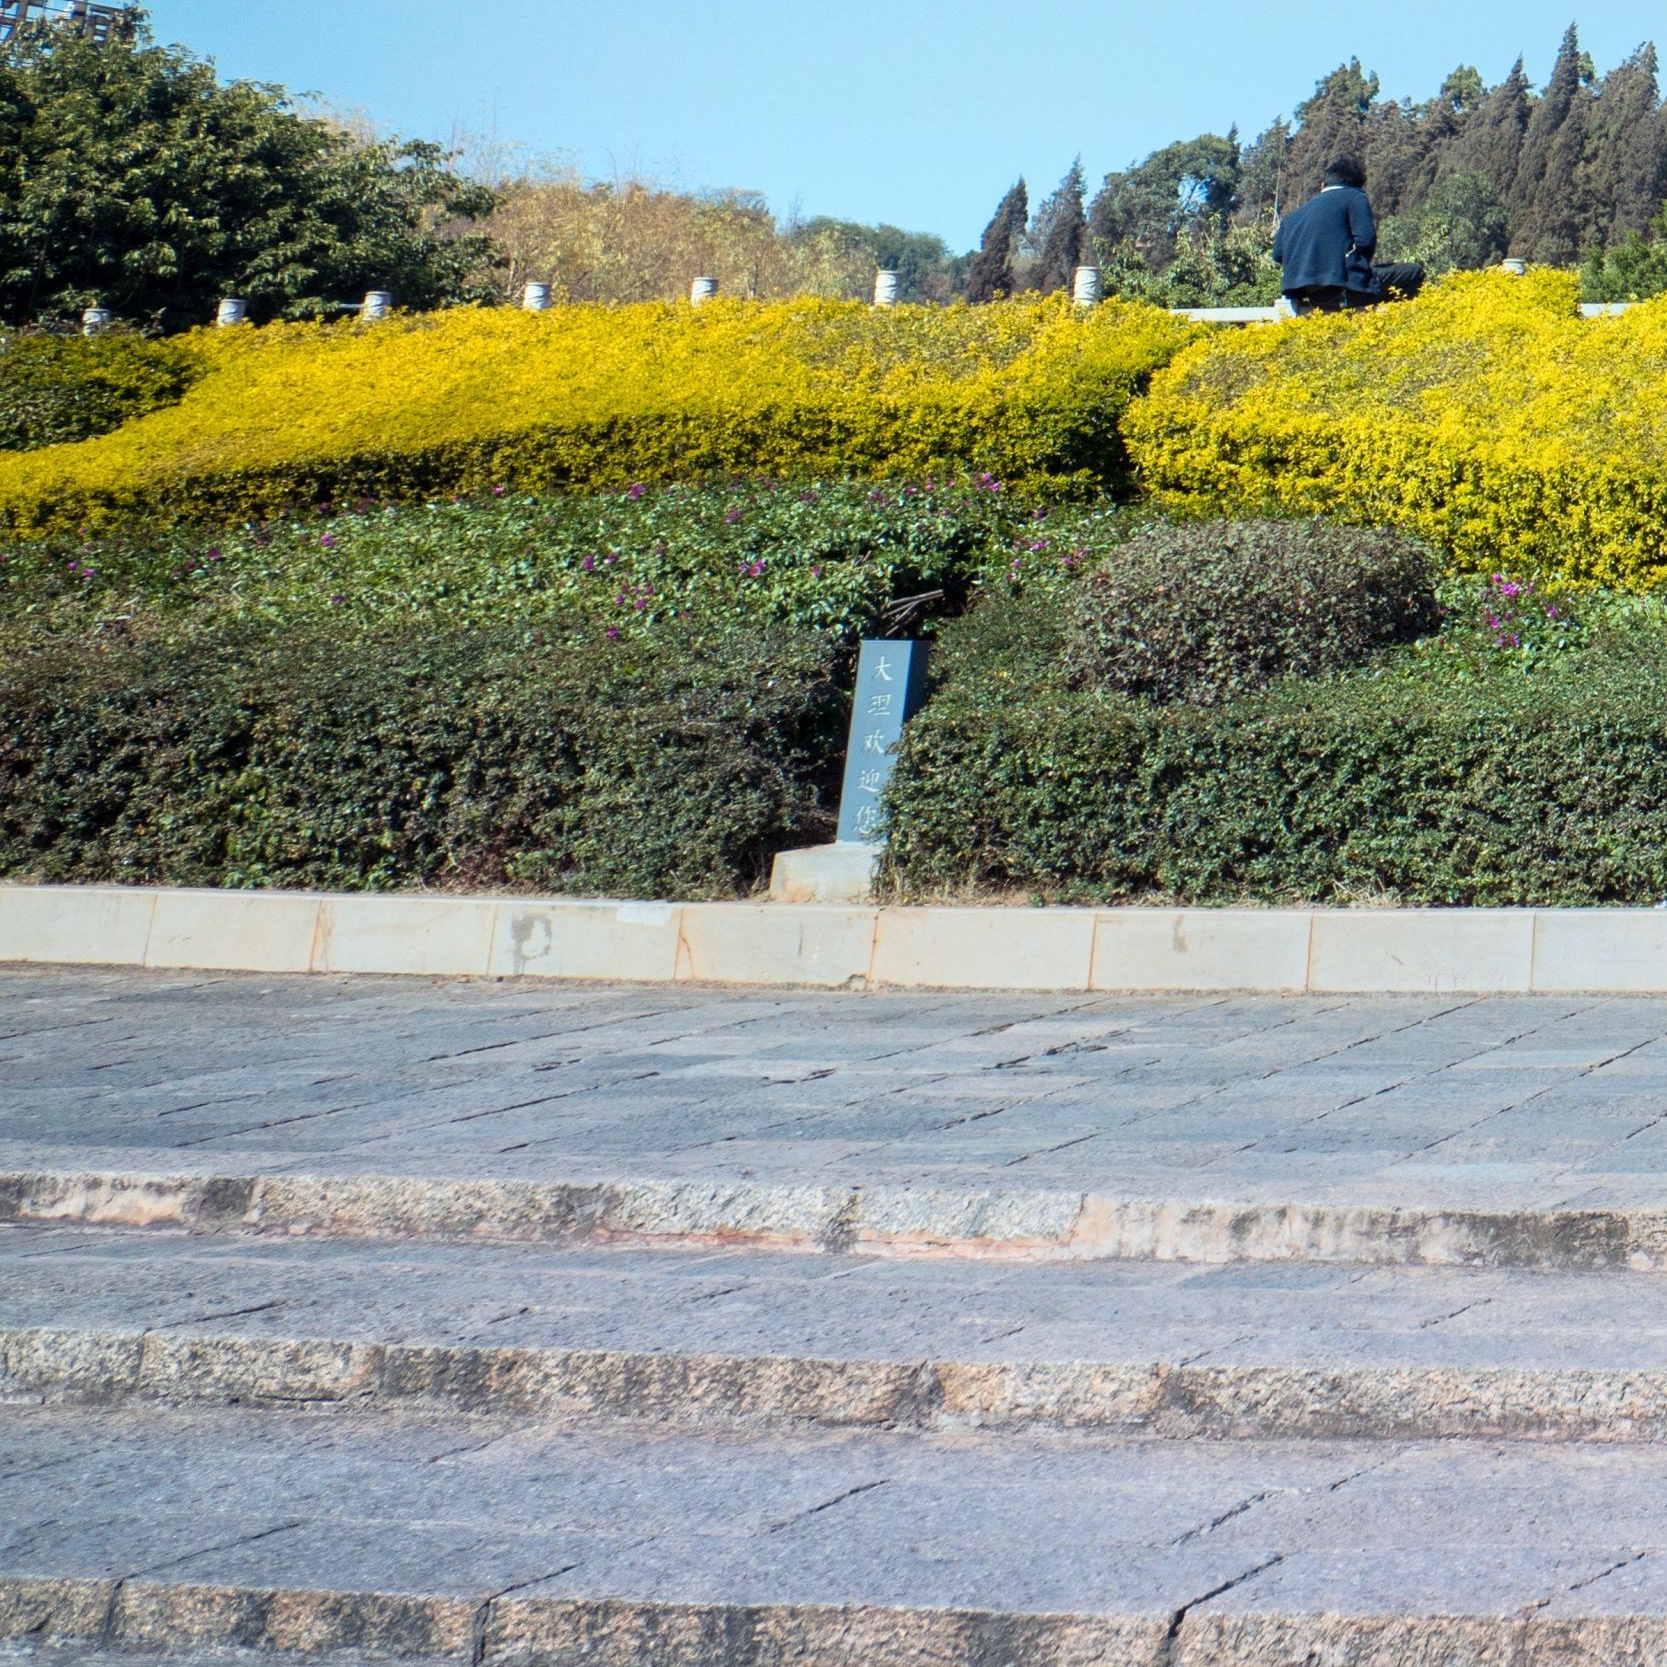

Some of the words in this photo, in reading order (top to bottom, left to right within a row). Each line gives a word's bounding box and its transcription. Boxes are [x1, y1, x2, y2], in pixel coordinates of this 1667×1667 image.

[853, 656, 893, 834] 大理欢迎您
